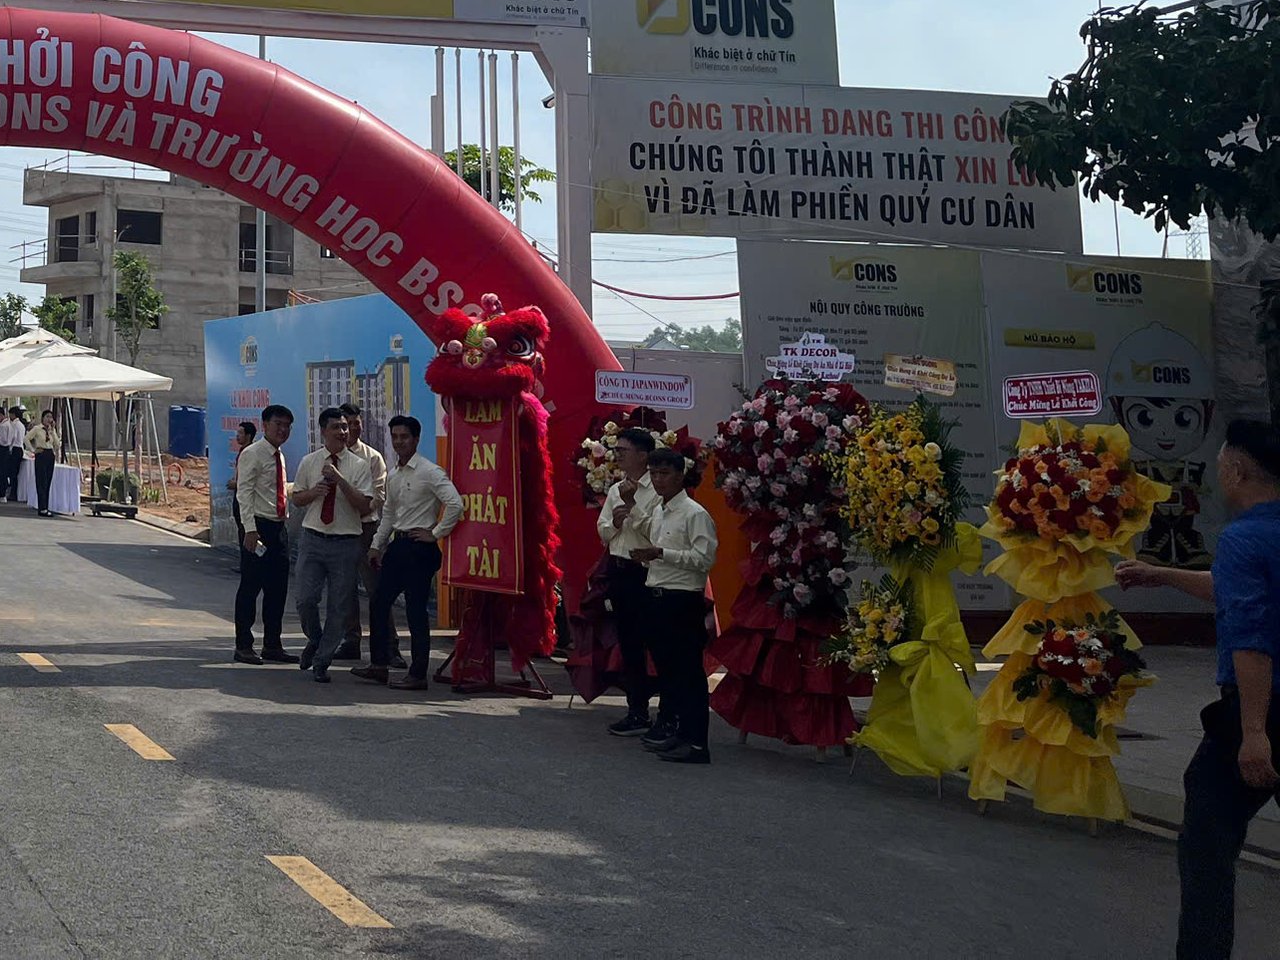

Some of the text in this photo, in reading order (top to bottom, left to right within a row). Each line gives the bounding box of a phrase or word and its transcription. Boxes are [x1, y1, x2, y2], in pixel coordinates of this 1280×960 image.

[694, 46, 720, 59] Khác
[723, 48, 743, 62] biệt
[756, 49, 776, 61] chữ
[779, 50, 796, 63] Tín
[92, 41, 225, 118] CÔNG
[649, 93, 1007, 144] CÔNG TRÌNH ĐANG THI CÔN
[628, 135, 723, 173] CHÚNG
[733, 139, 776, 175] TÔI
[785, 142, 873, 179] THÀNH
[882, 145, 946, 190] THẬT
[955, 155, 997, 184] XIN
[85, 100, 137, 147] VÀ
[150, 112, 320, 214] TRƯỜNG
[315, 195, 404, 268] HỌC
[644, 179, 1036, 231] VÌ ĐÃ LÀM PHIỀN QUÝ CƯ DÂN
[809, 299, 925, 318] NỘI QUY CÔNG TRƯỜNG
[783, 347, 798, 356] TK
[800, 348, 837, 357] DECOR
[598, 375, 685, 392] CÔNG TY JAPANWINDOW
[667, 396, 688, 404] GROUP
[468, 434, 497, 471] ĂN
[459, 486, 508, 525] PHÁT
[466, 538, 500, 579] TÀI
